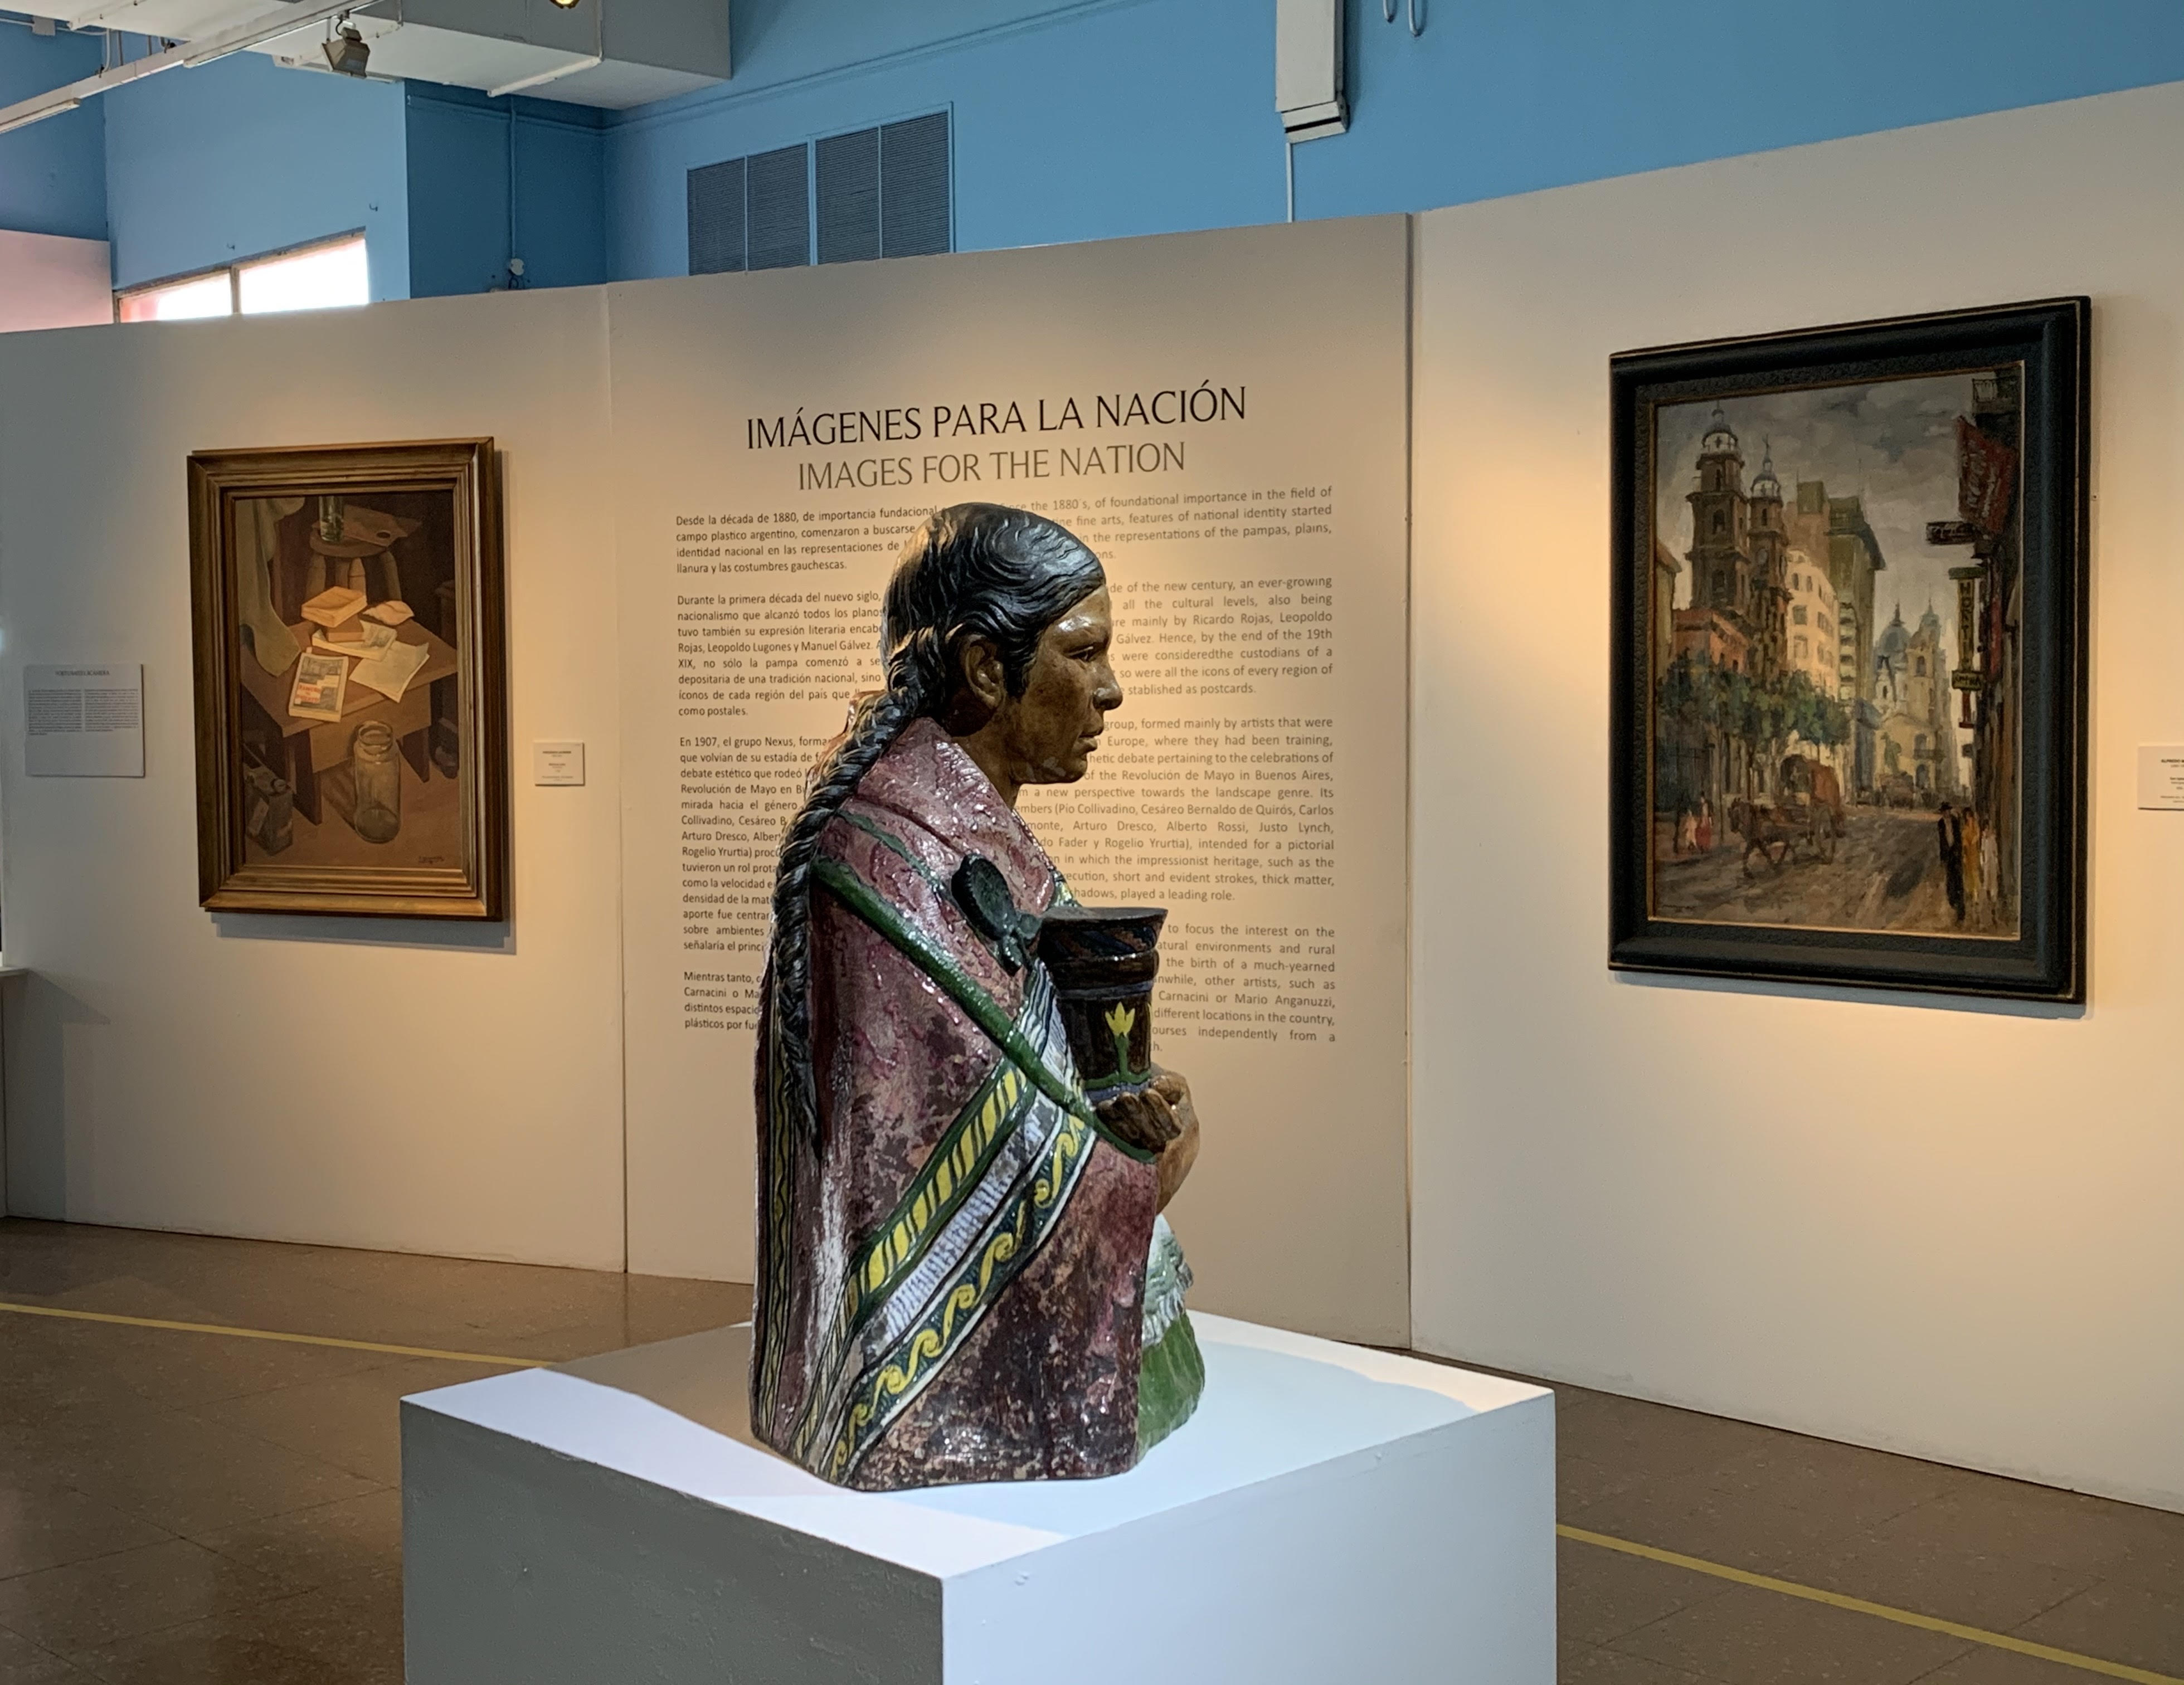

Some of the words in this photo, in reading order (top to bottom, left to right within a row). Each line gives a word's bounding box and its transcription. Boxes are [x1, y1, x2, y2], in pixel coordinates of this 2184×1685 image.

[747, 407, 922, 449] IMÁGENES
[933, 401, 1027, 437] PARA
[1039, 397, 1084, 431] LA
[1096, 379, 1246, 427] NACIÓN
[799, 457, 913, 490] IMAGES
[923, 454, 981, 483] FOR
[989, 449, 1050, 479] THE
[1060, 441, 1185, 476] NATION
[676, 515, 705, 526] Desde
[708, 515, 717, 524] la
[720, 514, 753, 525] década
[757, 513, 770, 523] de
[773, 512, 799, 523] 1880,
[802, 512, 815, 522] de
[819, 510, 876, 522] importancia
[1076, 515, 1097, 525] fine
[1101, 515, 1125, 525] arts,
[1129, 513, 1174, 524] features
[1178, 510, 1190, 522] of
[1194, 508, 1239, 520] national
[1243, 507, 1287, 519] identity
[1291, 504, 1332, 517] started
[676, 533, 708, 543] campo
[750, 530, 797, 541] argentino,
[801, 528, 860, 538] comenzaron
[873, 525, 916, 535] buscarse
[677, 547, 721, 557] identidad
[724, 546, 763, 556] nacional
[784, 545, 797, 554] las
[801, 544, 883, 555] representaciones
[887, 540, 899, 551] de
[677, 563, 708, 573] llanura
[711, 566, 717, 574] y
[719, 563, 732, 573] las
[734, 562, 789, 572] costumbres
[1127, 582, 1138, 593] of
[1142, 582, 1160, 592] the
[1164, 583, 1188, 591] new
[1191, 581, 1236, 591] century,
[1240, 580, 1254, 588] an
[1258, 577, 1332, 590] ever-growing
[677, 595, 715, 605] Durante
[717, 595, 726, 604] la
[729, 596, 766, 606] primera
[768, 593, 803, 603] década
[805, 592, 821, 602] del
[824, 593, 854, 602] nuevo
[856, 591, 881, 603] siglo,
[677, 611, 739, 621] nacionalismo
[742, 612, 761, 622] que
[764, 609, 800, 620] alcanzó
[803, 608, 830, 619] todos
[834, 608, 848, 618] los
[1131, 616, 1169, 628] mainly
[1174, 615, 1188, 627] by
[1193, 613, 1235, 625] Ricardo
[1240, 613, 1273, 626] Rojas,
[1280, 611, 1333, 624] Leopoldo
[678, 642, 706, 654] Rojas,
[707, 642, 751, 654] Leopoldo
[752, 643, 792, 654] Lugones
[793, 644, 800, 653] y
[801, 641, 838, 651] Manuel
[1240, 647, 1301, 659] custodians
[1307, 646, 1319, 657] of
[1326, 649, 1333, 657] a
[678, 675, 731, 686] depositaria
[733, 674, 746, 684] de
[769, 673, 812, 684] tradición
[814, 673, 858, 684] nacional,
[1185, 686, 1198, 694] as
[678, 708, 706, 716] como
[679, 737, 692, 747] En
[694, 737, 720, 747] 1907,
[722, 737, 732, 746] el
[734, 738, 762, 748] grupo
[765, 737, 796, 747] Nexus,
[1107, 736, 1149, 748] Europe,
[1154, 735, 1189, 746] where
[1194, 735, 1219, 748] they
[1224, 734, 1246, 745] had
[1251, 734, 1280, 746] been
[1285, 734, 1333, 747] training,
[680, 768, 713, 778] debate
[714, 770, 752, 778] estético
[753, 771, 772, 780] que
[774, 768, 802, 778] rodeó
[1098, 770, 1117, 780] the
[1121, 770, 1181, 780] Revolución
[1185, 770, 1200, 780] de
[1204, 770, 1236, 782] Mayo
[1255, 770, 1297, 780] Buenos
[1301, 770, 1334, 781] Aires,
[680, 800, 713, 809] mirada
[719, 800, 744, 810] hacia
[749, 800, 758, 810] el
[764, 800, 797, 811] género
[1077, 803, 1139, 815] Collivadino,
[1140, 803, 1185, 815] Cesáreo
[1187, 804, 1237, 815] Bernaldo
[1238, 804, 1253, 815] de
[1255, 804, 1296, 816] Quirós,
[1298, 805, 1334, 815] Carlos
[681, 815, 735, 826] Collivadino,
[738, 815, 776, 825] Cesáreo
[1058, 836, 1088, 848] Fader
[1093, 840, 1100, 850] y
[1105, 837, 1144, 850] Rogelio
[1149, 838, 1193, 850] Yrurtia),
[1198, 838, 1248, 850] intended
[1253, 839, 1270, 849] for
[1275, 841, 1282, 850] a
[1288, 840, 1334, 851] pictorial
[683, 924, 709, 934] sobre
[716, 926, 765, 936] ambientes
[1166, 957, 1185, 967] the
[1190, 957, 1217, 968] birth
[1223, 958, 1234, 969] of
[1241, 961, 1248, 970] a
[1253, 960, 1335, 973] much-yearned
[684, 972, 725, 982] Mientras
[727, 973, 754, 984] tanto,
[1158, 990, 1209, 1002] Carnacini
[1215, 995, 1228, 1003] or
[1234, 994, 1268, 1005] Mario
[1275, 995, 1335, 1009] Anganuzzi,
[1154, 1007, 1200, 1020] different
[1203, 1009, 1252, 1021] locations
[1254, 1012, 1265, 1021] in
[1268, 1012, 1286, 1023] the
[1289, 1015, 1335, 1026] country,
[684, 1017, 724, 1029] plásticos
[726, 1021, 743, 1030] por
